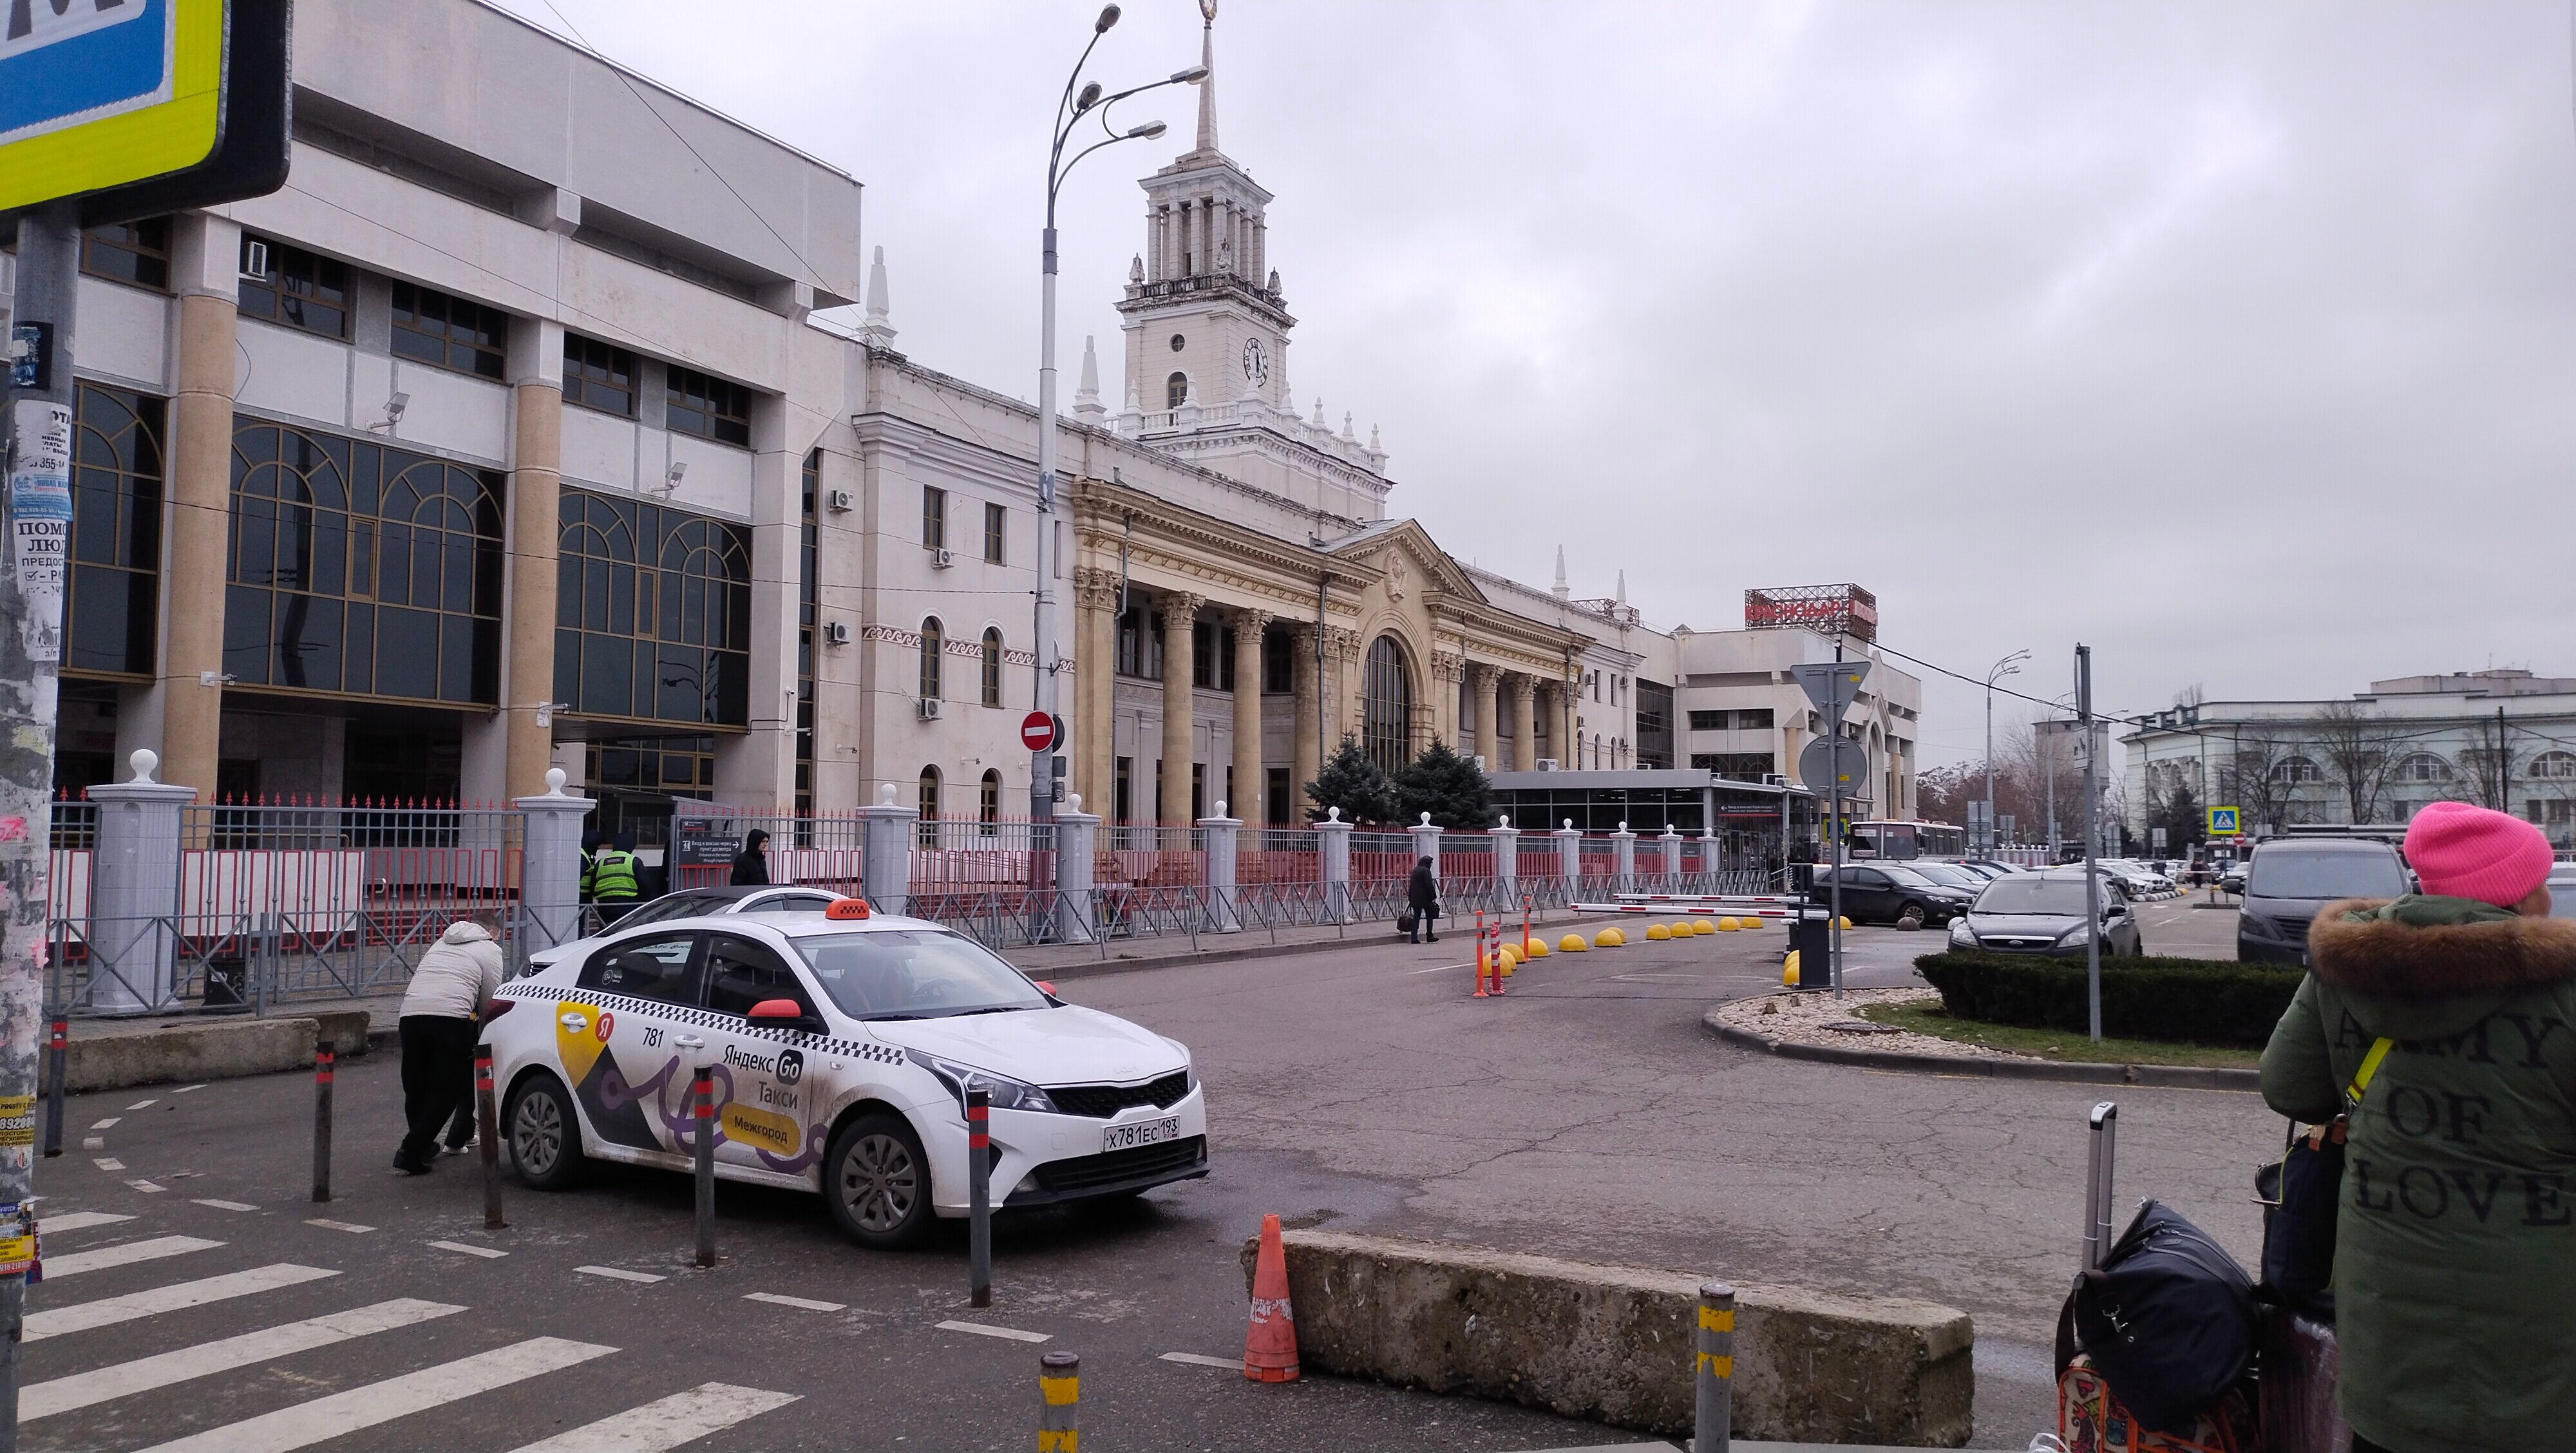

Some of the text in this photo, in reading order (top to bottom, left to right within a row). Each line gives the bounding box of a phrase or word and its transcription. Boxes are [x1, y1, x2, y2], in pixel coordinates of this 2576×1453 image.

[18, 522, 66, 535] ПОМ
[599, 1018, 610, 1038] Я
[643, 1027, 664, 1048] 781
[723, 1044, 800, 1079] Яндекс Go
[759, 1081, 799, 1110] Такси
[734, 1115, 788, 1144] Межгород
[1160, 1118, 1178, 1134] 193
[2386, 1085, 2491, 1145] OF
[2353, 1157, 2572, 1227] LOVE
